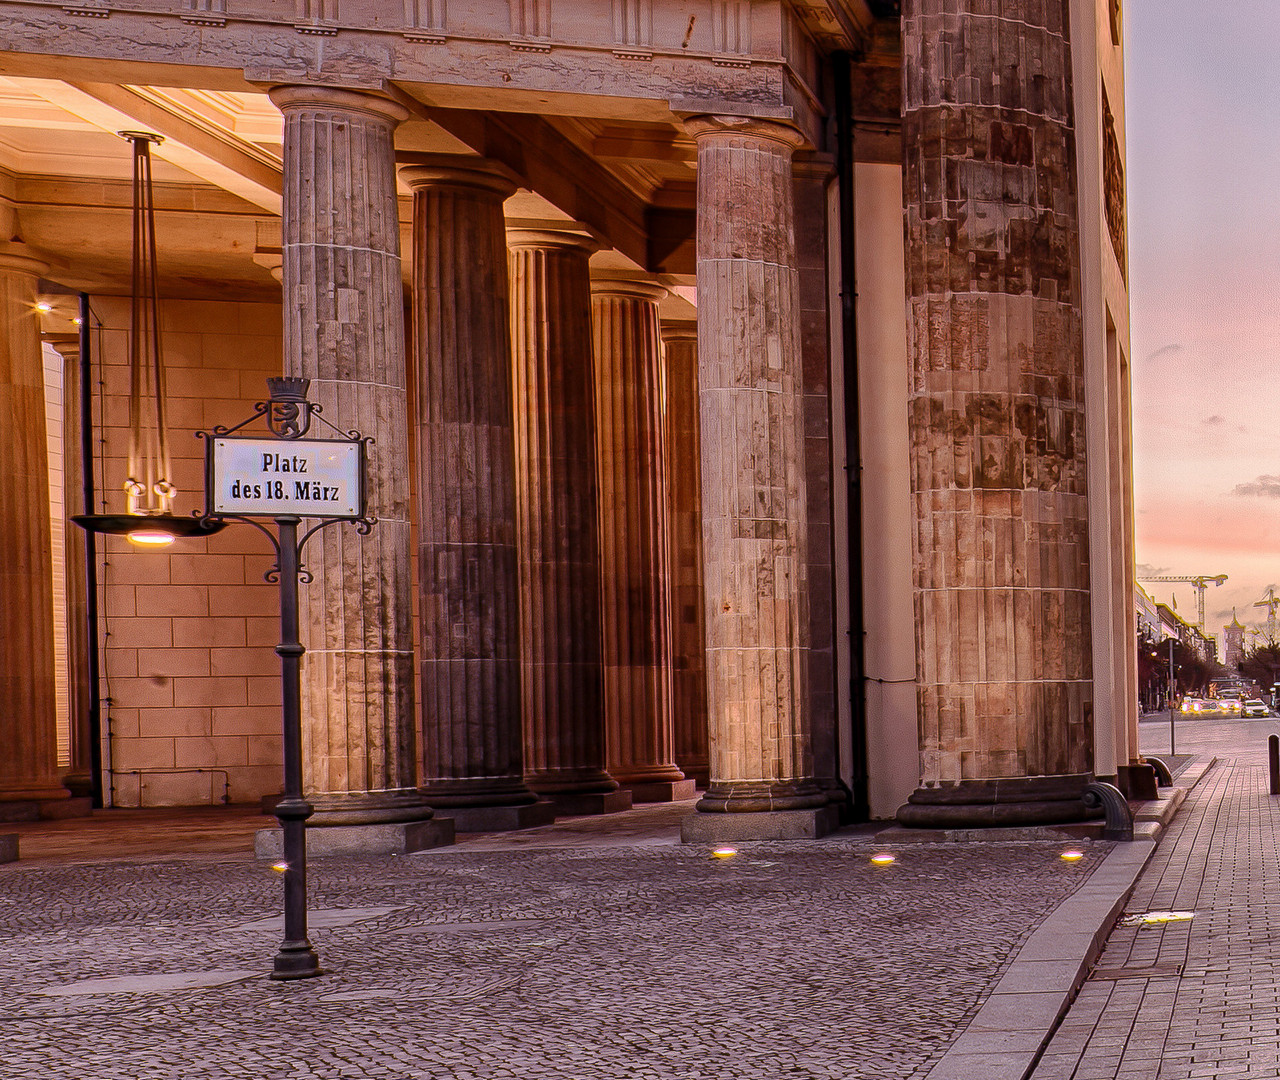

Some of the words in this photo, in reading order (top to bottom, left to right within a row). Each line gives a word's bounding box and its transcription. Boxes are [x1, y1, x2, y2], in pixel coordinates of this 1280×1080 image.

[262, 453, 308, 473] Platz
[232, 479, 261, 499] des
[266, 480, 290, 500] 18.
[295, 481, 339, 501] März
